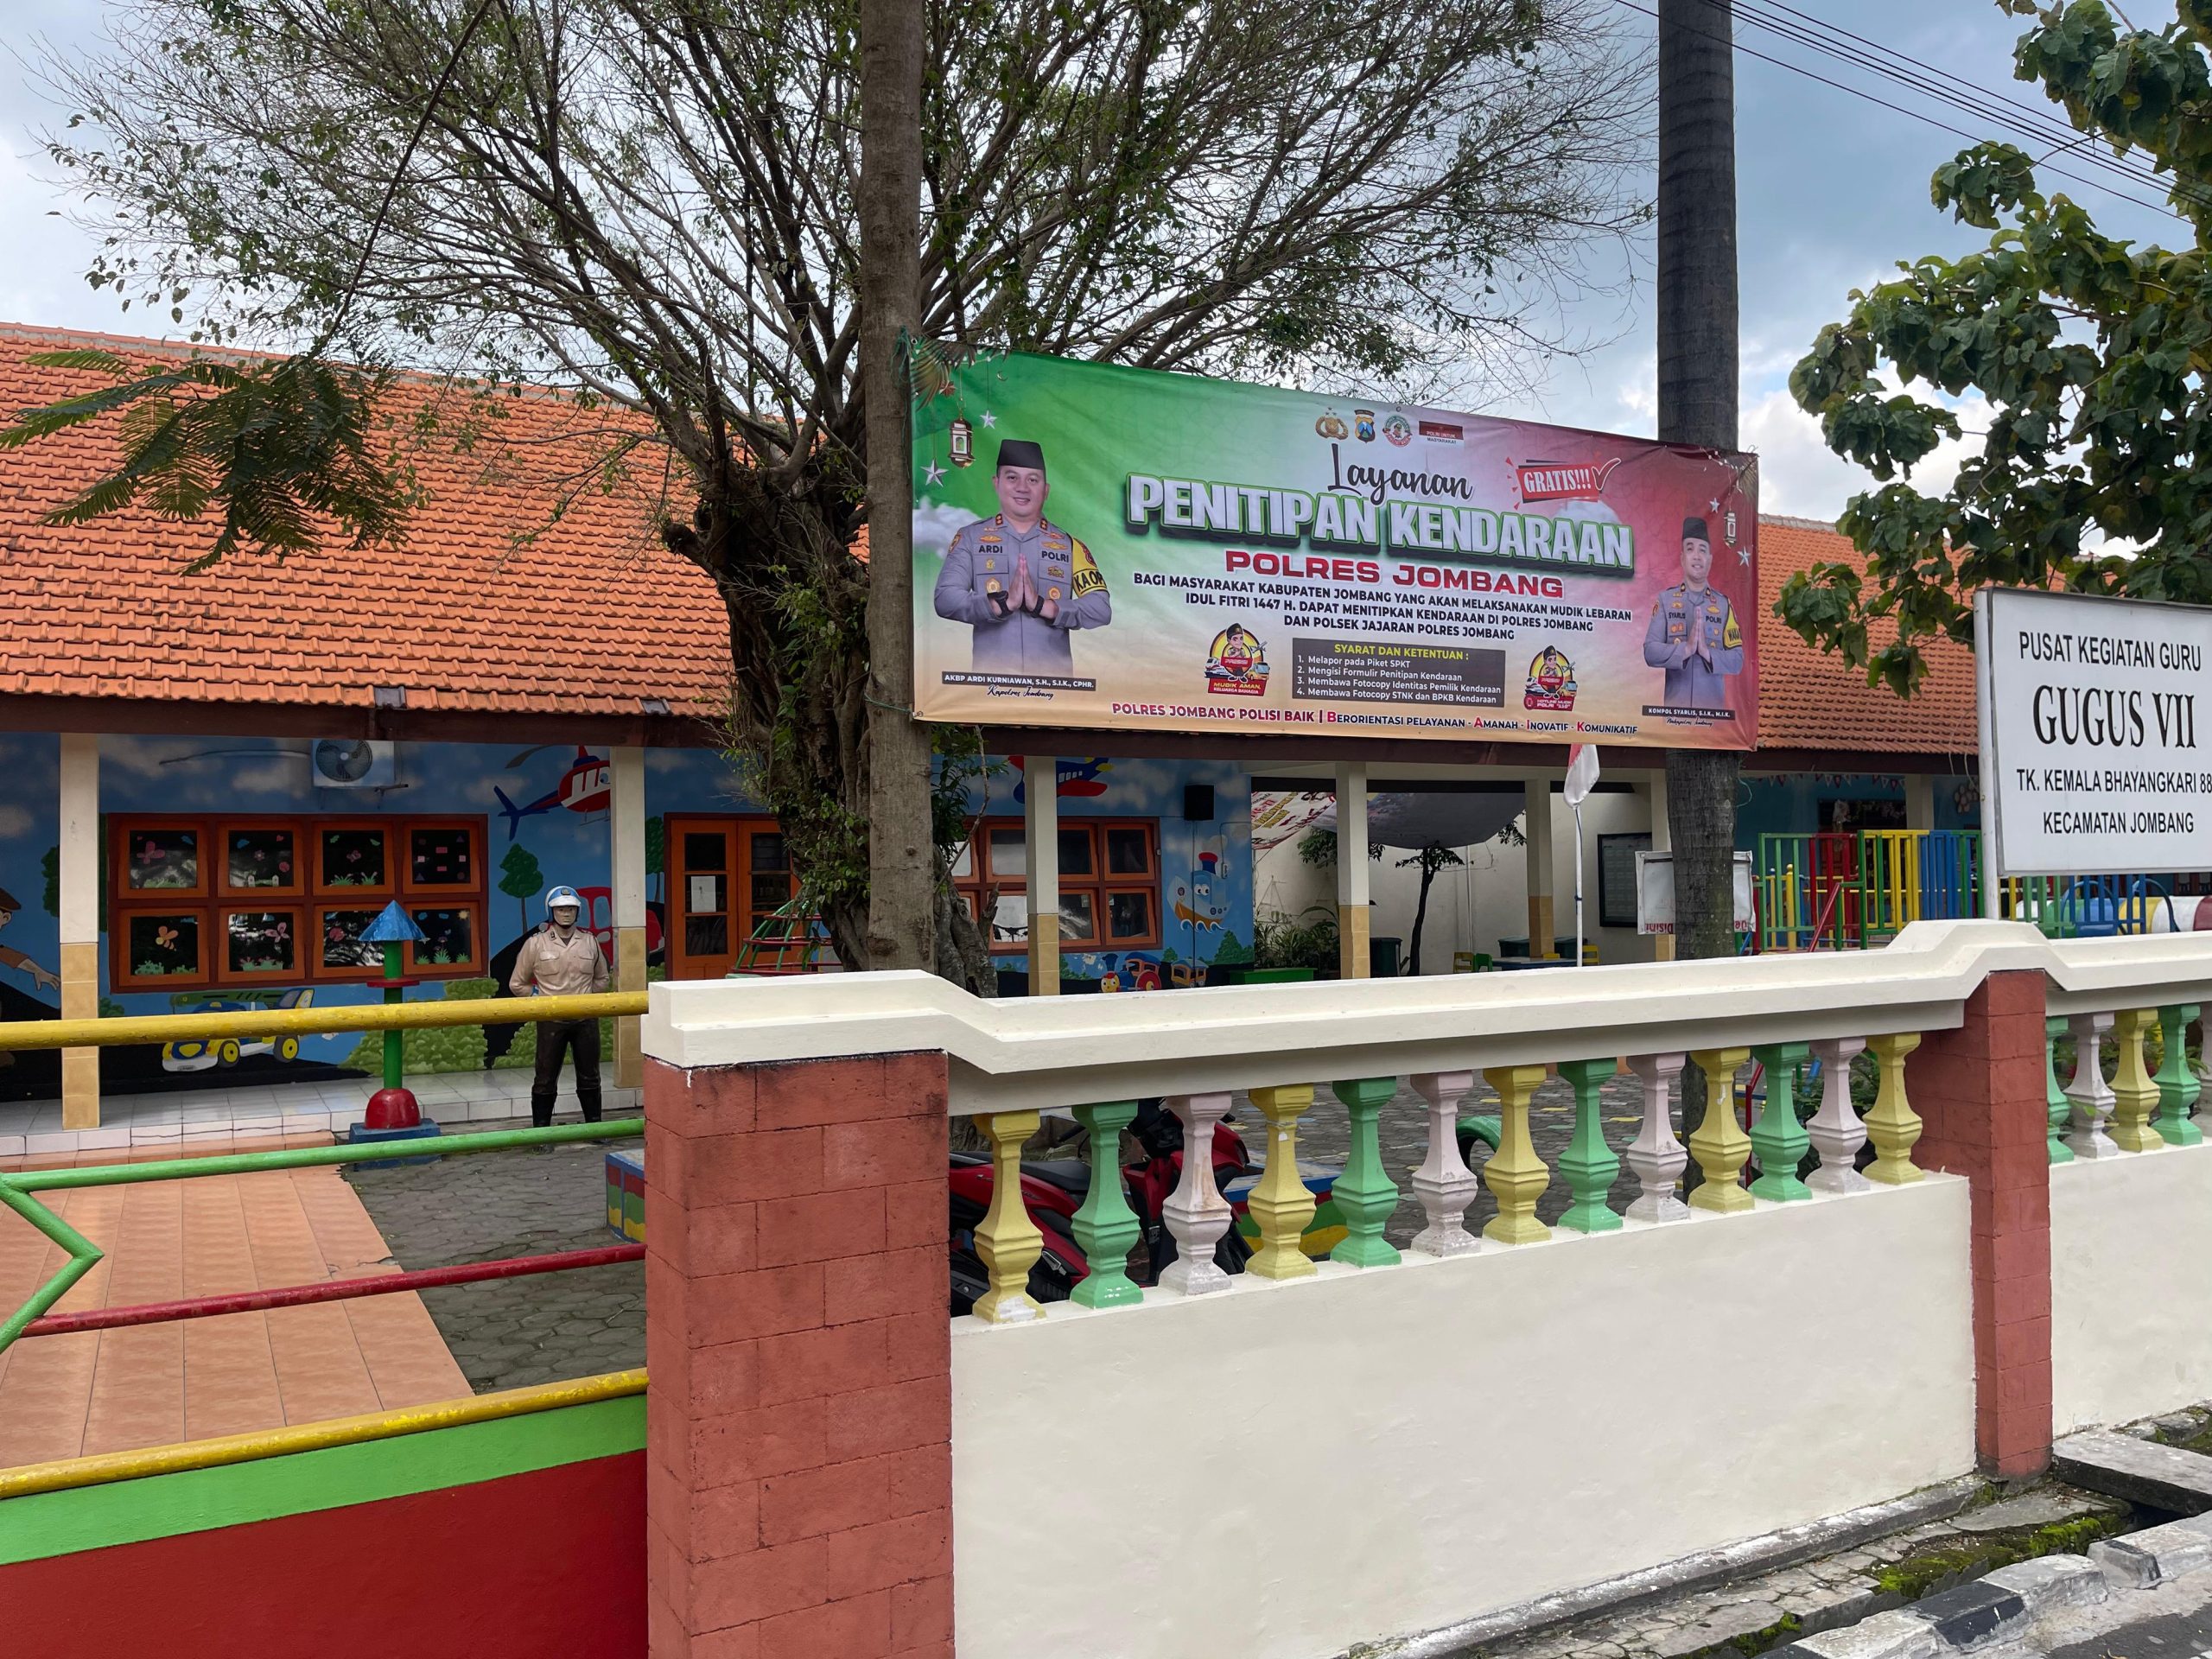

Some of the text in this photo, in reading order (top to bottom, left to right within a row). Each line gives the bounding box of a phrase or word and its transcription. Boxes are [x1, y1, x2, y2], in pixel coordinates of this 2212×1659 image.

[1327, 442, 1473, 505] Layanan
[1523, 468, 1592, 493] GRATIS!!!
[1128, 474, 1632, 568] PENITIPAN KENDARAAN
[978, 544, 1003, 554] ARDI
[1041, 550, 1070, 563] POLRI
[1225, 550, 1563, 599] POLRES JOMBANG
[1134, 573, 1631, 621] BAGI MASYARAKAT KABUPATEN JOMBANG YANG AKAN MELAKSANAKAN MUDIK LEBARAN
[1185, 593, 1593, 632] IDUL FITRI 1447 H. DAPAT MENITIPKAN KENDARAAN DI POLRES JOMBANG
[1705, 615, 1722, 624] POLRI
[1283, 614, 1515, 640] DAN POLSEK JAJARAN POLRES JOMBANG
[1297, 655, 1411, 669] 1. Melapor pada Piket SPKT
[1334, 643, 1376, 656] SYARAT
[1378, 646, 1401, 657] DAN
[1403, 647, 1464, 660] KETENTUAN
[2019, 631, 2202, 671] PUSAT KEGIATAN GURU
[944, 674, 966, 683] AKBP
[967, 675, 986, 683] ARDI
[987, 676, 1034, 685] KURNIAWAN,
[1297, 677, 1502, 694] 3. Membawa Fotocopy Identitas Pemilik Kendaraan
[1308, 666, 1341, 677] Mengisi
[1343, 668, 1378, 677] Formulir
[1380, 670, 1419, 680] Penitipan
[1420, 671, 1462, 682] Kendaraan
[1307, 688, 1351, 698] Membawa
[1352, 690, 1390, 700] Fotocopy
[1392, 691, 1414, 700] STNK
[1414, 692, 1430, 701] dan
[1432, 693, 1454, 702] BPKB
[1456, 694, 1497, 703] Kendaraan
[1112, 702, 1166, 717] POLRES
[1168, 705, 1236, 720] JOMBANG
[1239, 708, 1281, 721] POLISI
[1284, 710, 1315, 722] BAIK
[1327, 710, 1404, 726] BERORIENTASI
[1406, 716, 1465, 728] PELAYANAN
[1473, 716, 1518, 729] AMANAH
[1526, 719, 1569, 731] INOVATIF
[1577, 721, 1638, 734] KOMUNIKATIF
[2032, 684, 2196, 749] GUGUS VII
[2017, 768, 2040, 791] TK.
[2044, 769, 2101, 792] KEMALA
[2105, 771, 2196, 793] BHAYANGKARI
[2043, 812, 2194, 834] KECAMATAN JOMBANG
